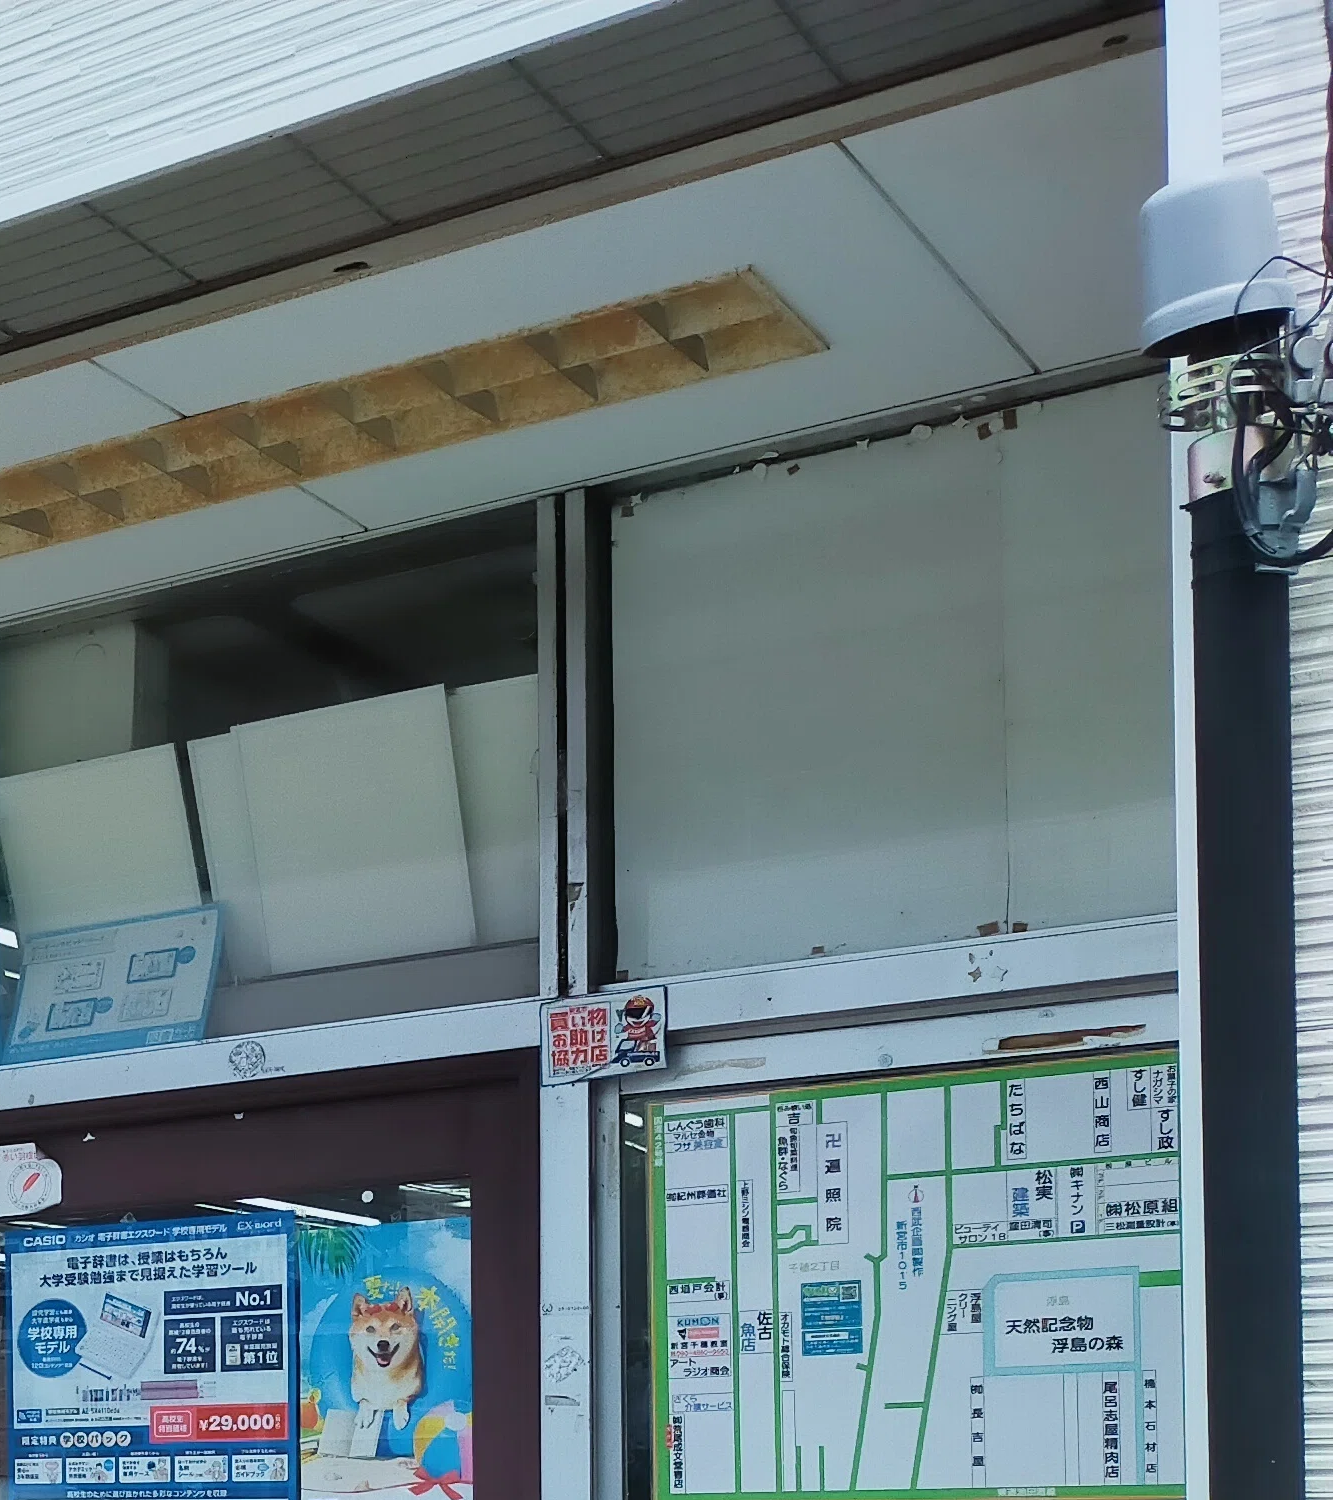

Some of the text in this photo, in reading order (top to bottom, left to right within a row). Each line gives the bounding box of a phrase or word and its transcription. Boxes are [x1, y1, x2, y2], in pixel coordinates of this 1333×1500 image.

[549, 1006, 608, 1032] 買い物
[552, 1028, 607, 1049] お助け
[551, 1044, 609, 1068] 協力店
[1131, 1068, 1148, 1107] すし健
[1152, 1069, 1164, 1104] ナガシマ
[787, 1112, 800, 1125] 吉
[1008, 1083, 1026, 1155] たちばな
[1094, 1077, 1110, 1147] 西山商店
[667, 1116, 726, 1132] しんぐう歯科
[1157, 1109, 1175, 1150] すし政
[1035, 1169, 1054, 1201] 松実
[1012, 1186, 1030, 1217] 建築
[23, 1234, 66, 1247] CASIO
[73, 1234, 95, 1243] カシオ
[171, 1224, 228, 1237] 学校専用モデル
[954, 1222, 999, 1234] ビューティ
[66, 1247, 228, 1270] 電子辞書は、授業はもちろん
[39, 1261, 258, 1288] 大学受験勉強まで見据えた学習ツール
[235, 1289, 272, 1307] No.1
[677, 1316, 720, 1326] KUMON
[757, 1311, 773, 1340] 佐古
[1005, 1315, 1094, 1335] 天然記念物
[27, 1325, 78, 1341] 学校専用
[740, 1322, 756, 1352] 魚店
[1051, 1335, 1124, 1353] 浮島の森
[35, 1341, 71, 1355] モデル
[243, 1350, 278, 1365] 第1位
[670, 1357, 696, 1367] アート
[683, 1365, 730, 1377] ラジオ商会
[198, 1413, 275, 1432] ¥29,000
[1102, 1381, 1120, 1478] 尾呂志屋精肉店
[1143, 1378, 1158, 1473] 橋本石材店
[61, 1431, 131, 1447] 学校パック
